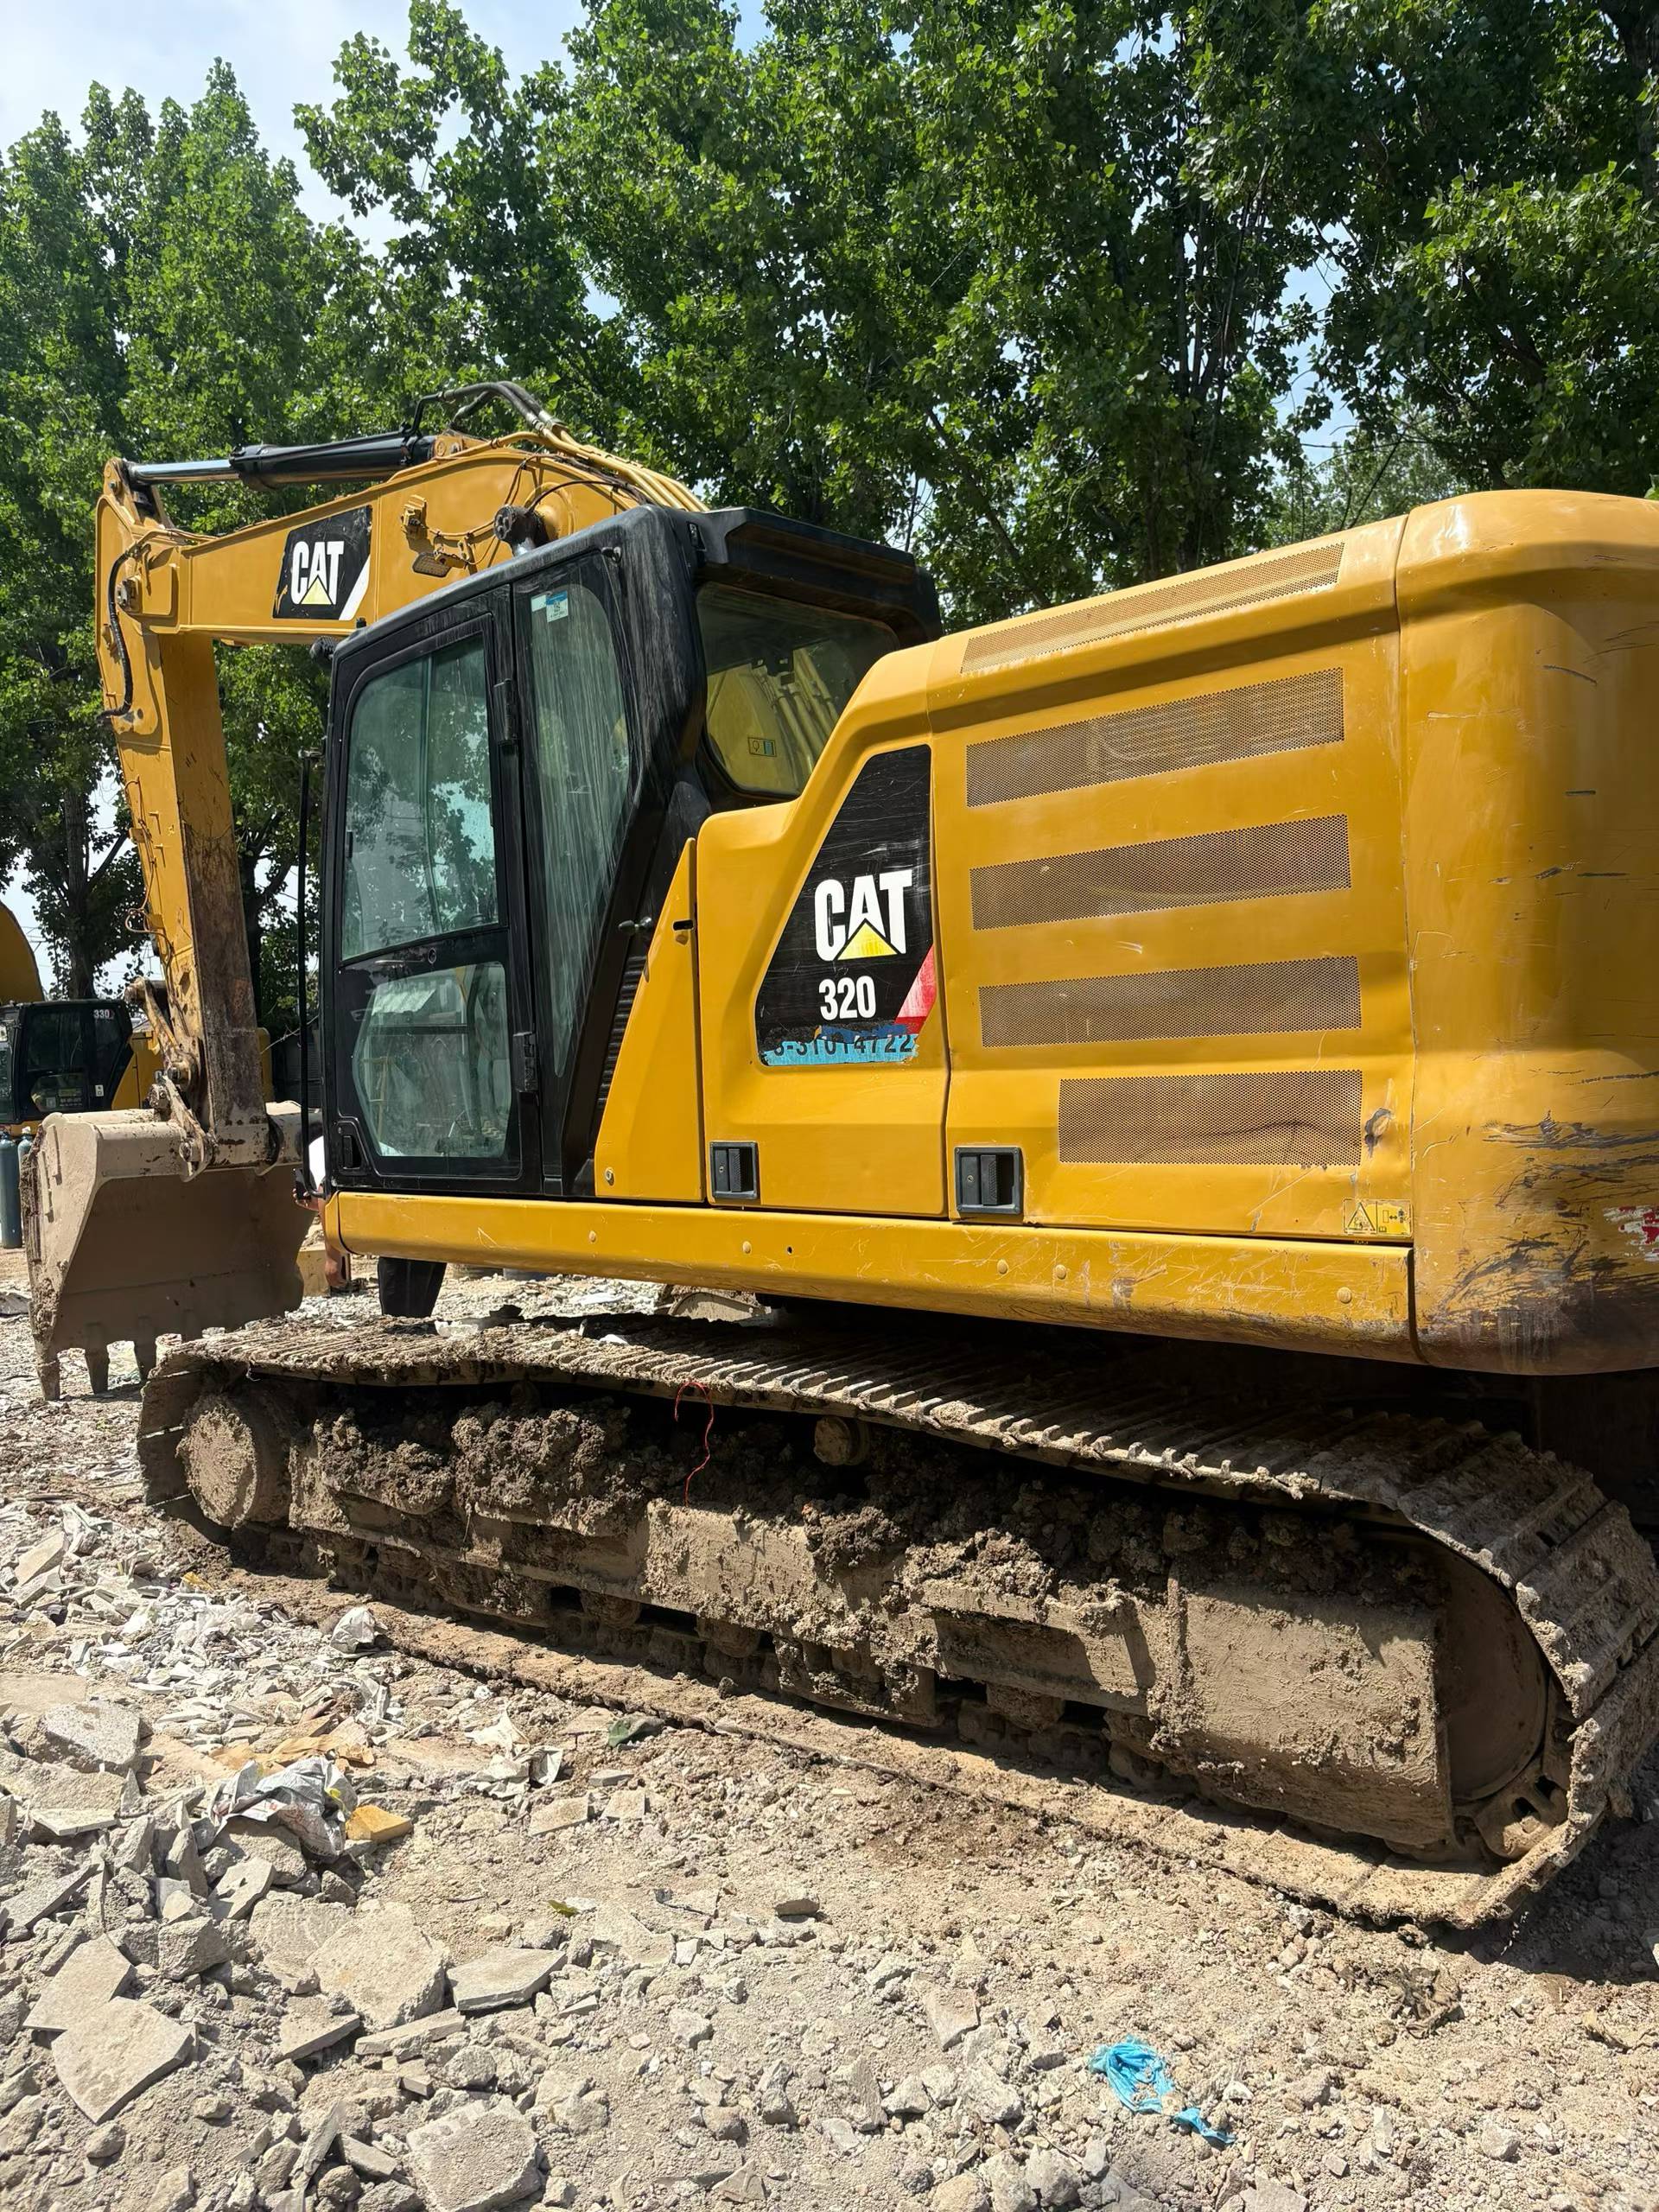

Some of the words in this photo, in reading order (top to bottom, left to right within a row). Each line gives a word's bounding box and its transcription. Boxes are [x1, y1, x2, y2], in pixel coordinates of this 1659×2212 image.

[290, 541, 345, 605] CAT
[814, 869, 912, 962] CAT
[818, 976, 876, 1020] 320
